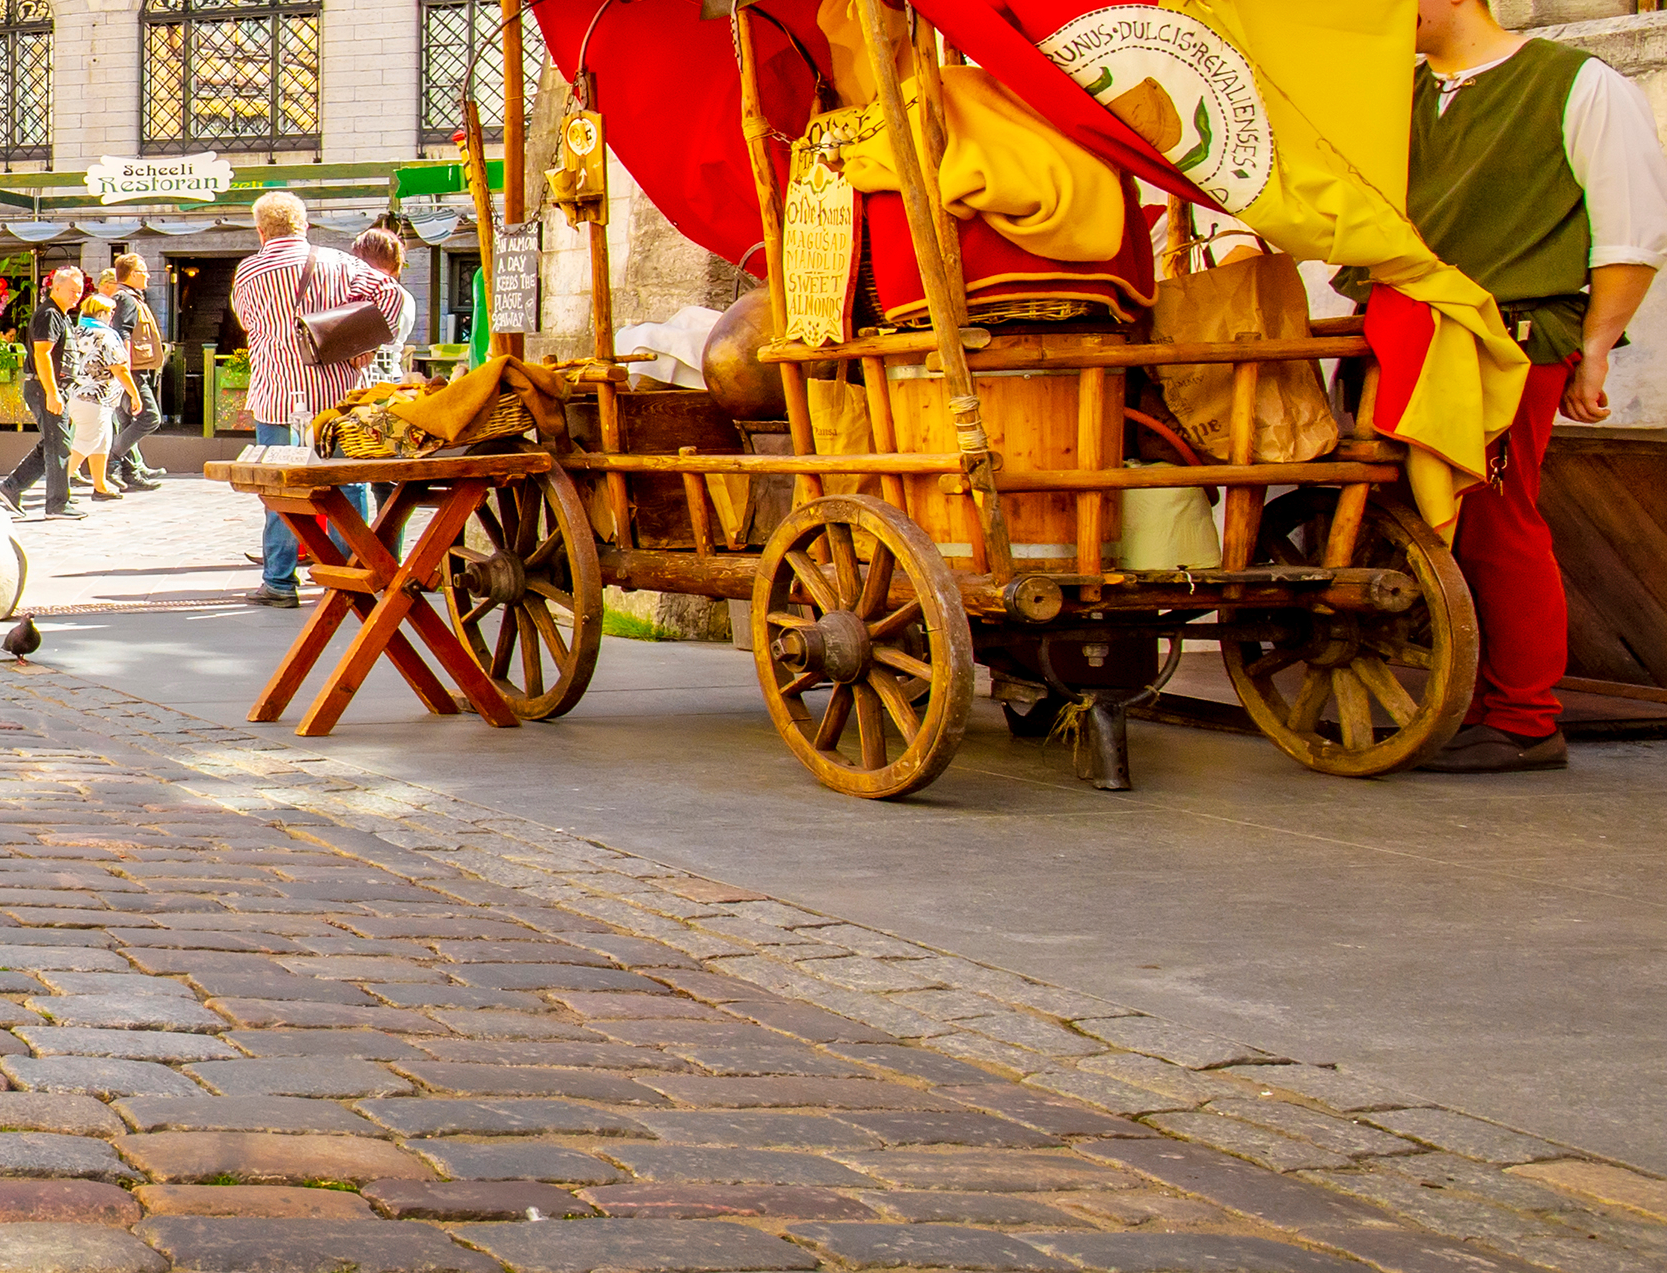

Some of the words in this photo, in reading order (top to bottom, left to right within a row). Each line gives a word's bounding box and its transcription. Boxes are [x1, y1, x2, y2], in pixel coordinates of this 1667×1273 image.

[1045, 24, 1114, 67] RUNUS
[123, 163, 193, 176] Scheeli
[98, 177, 219, 193] Restoran
[508, 254, 527, 272] DAY
[786, 250, 846, 271] MANDLID
[496, 274, 519, 292] KEEPS
[520, 273, 536, 290] THE
[788, 273, 843, 294] SWEET
[788, 295, 843, 323] ALMONDS
